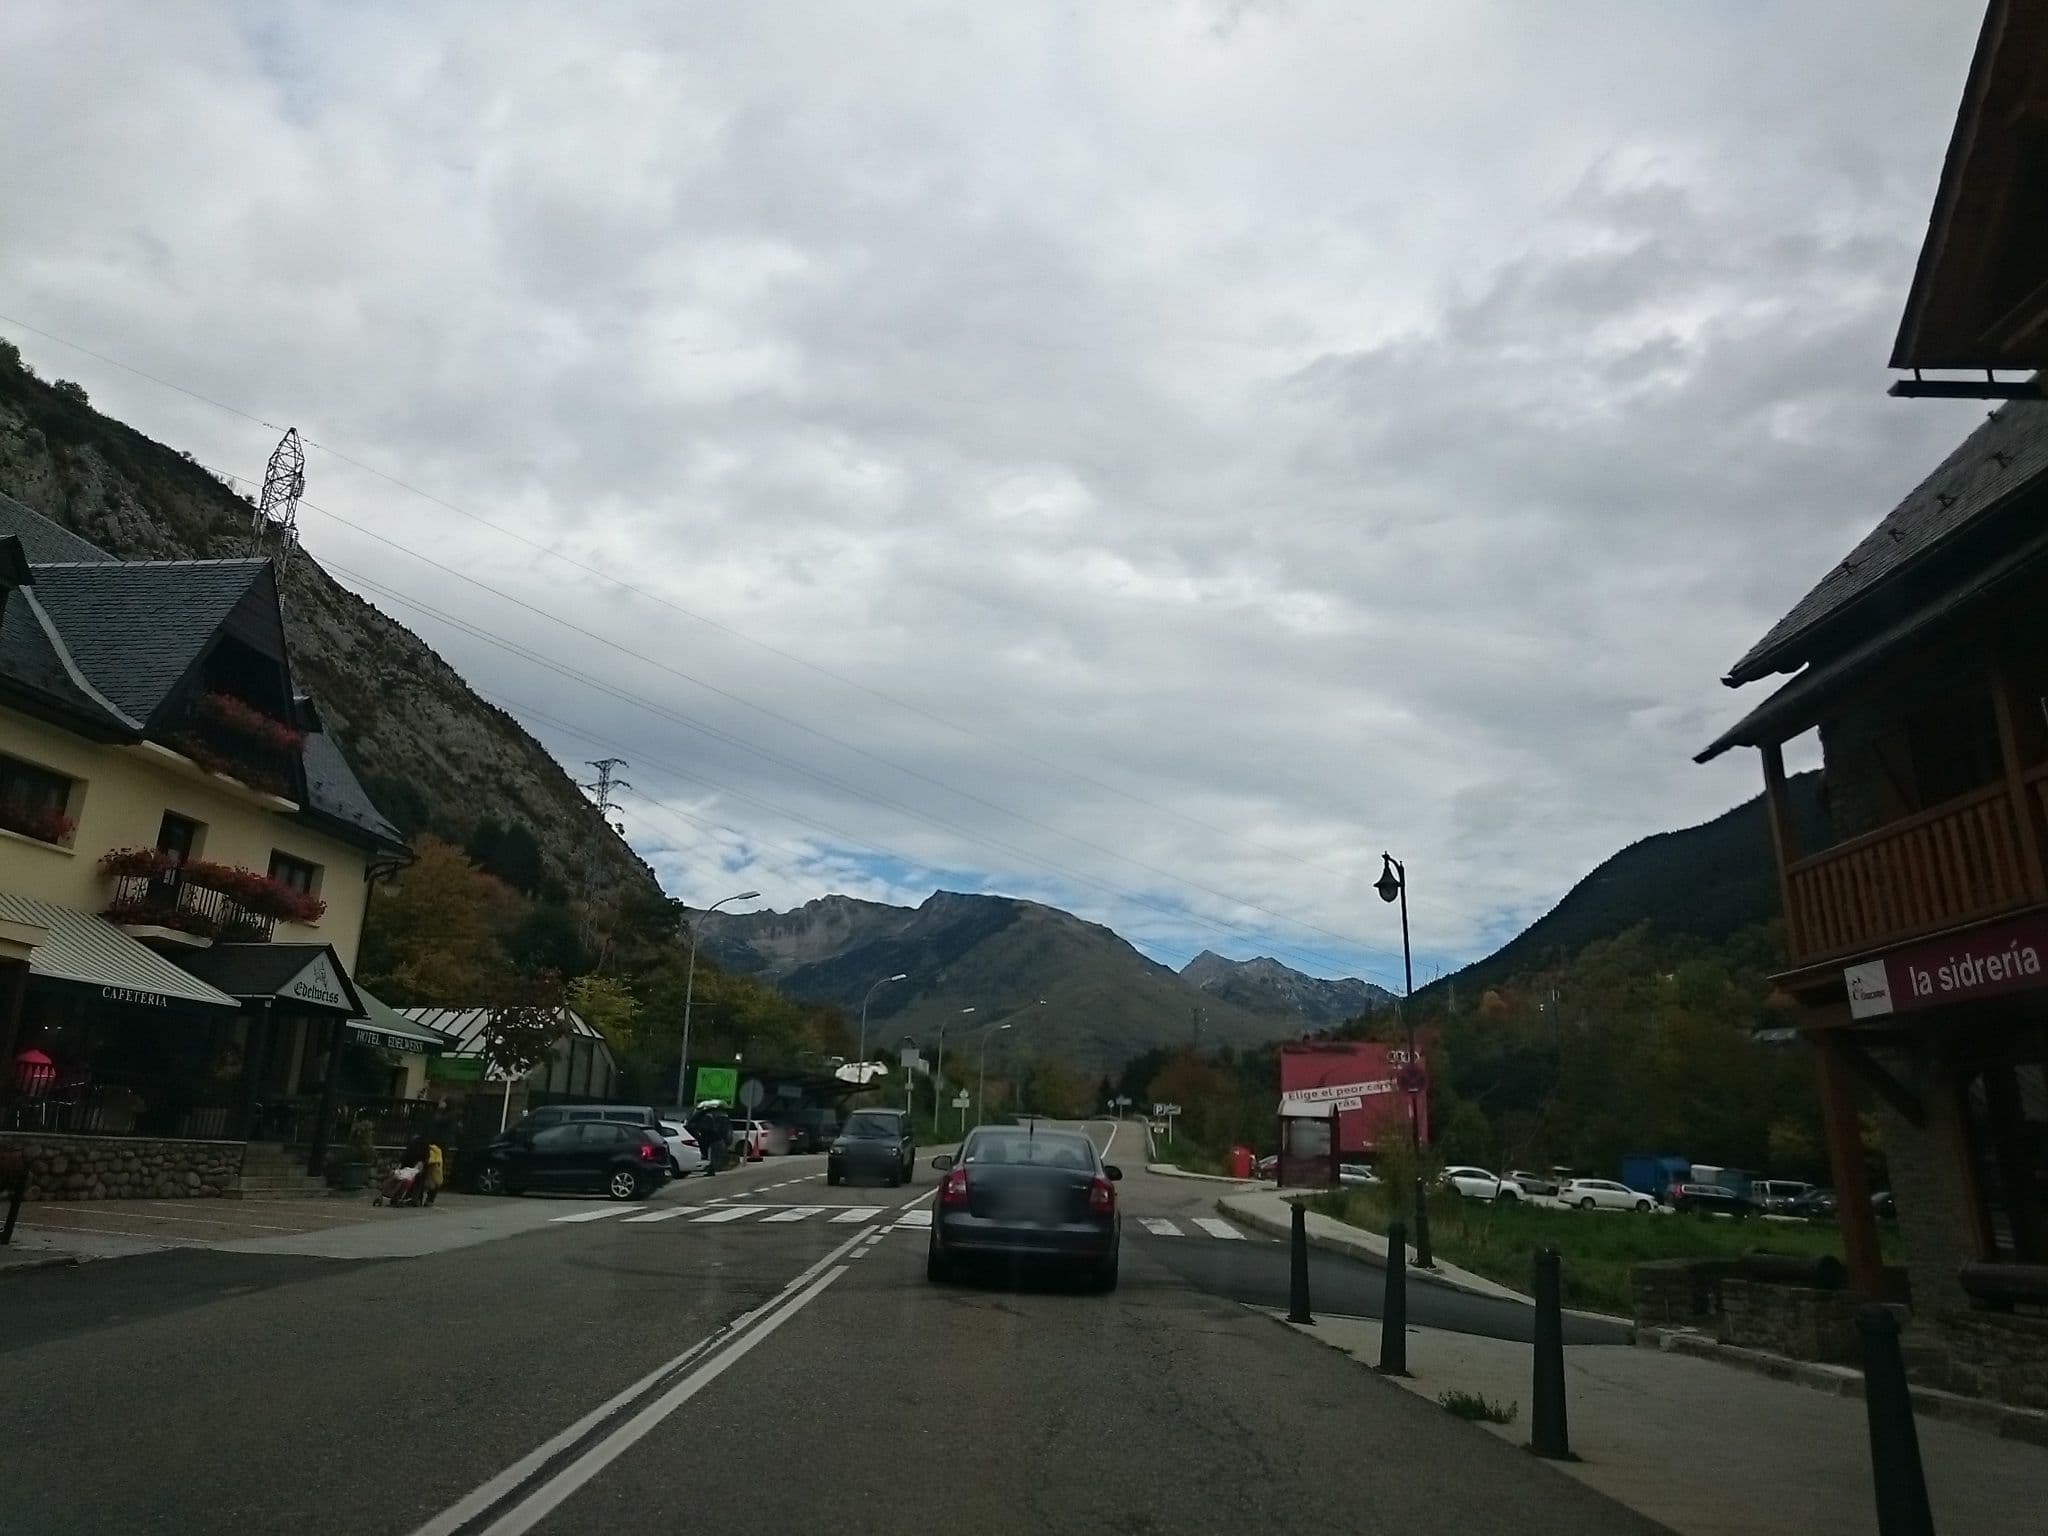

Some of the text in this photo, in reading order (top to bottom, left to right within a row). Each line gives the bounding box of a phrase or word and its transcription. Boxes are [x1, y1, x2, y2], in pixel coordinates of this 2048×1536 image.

[1909, 938, 2041, 996] la sidrería
[102, 986, 167, 1007] CAFETERIA
[294, 981, 339, 1004] Edelweiss
[1288, 1090, 1318, 1102] Elige
[1321, 1088, 1333, 1098] el
[1336, 1085, 1363, 1097] peor
